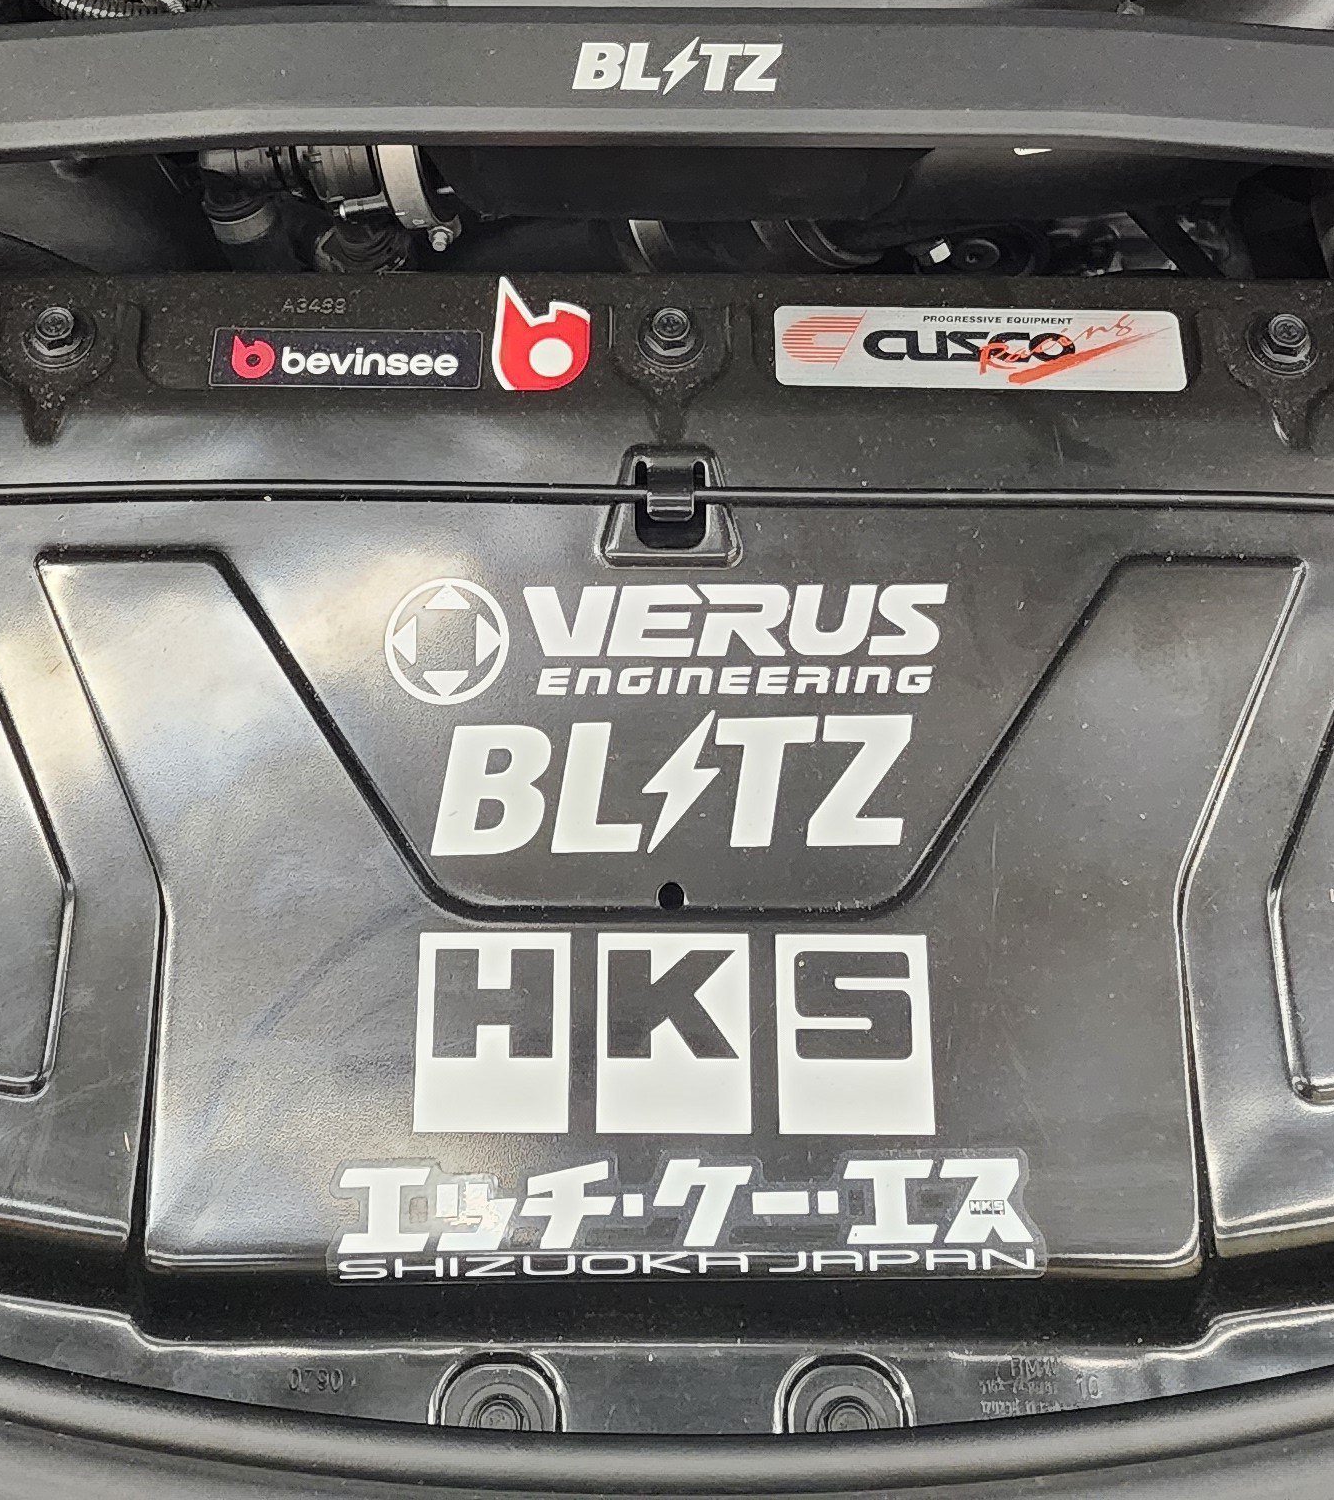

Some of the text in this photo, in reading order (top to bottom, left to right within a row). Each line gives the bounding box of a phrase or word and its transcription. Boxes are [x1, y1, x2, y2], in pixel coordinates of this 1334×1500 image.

[571, 36, 784, 95] BLITZ
[922, 315, 1073, 325] PROGRESSIVE EQUIPMENT
[281, 346, 459, 376] bevinsee
[863, 330, 1076, 362] CUSCO
[523, 583, 947, 657] VERUS
[535, 665, 933, 697] ENGINEERING
[430, 709, 913, 857] BLITZ
[425, 942, 919, 1068] HKS
[969, 1200, 1005, 1213] HKS
[339, 1248, 1036, 1280] SHIZUOKA JAPAN
